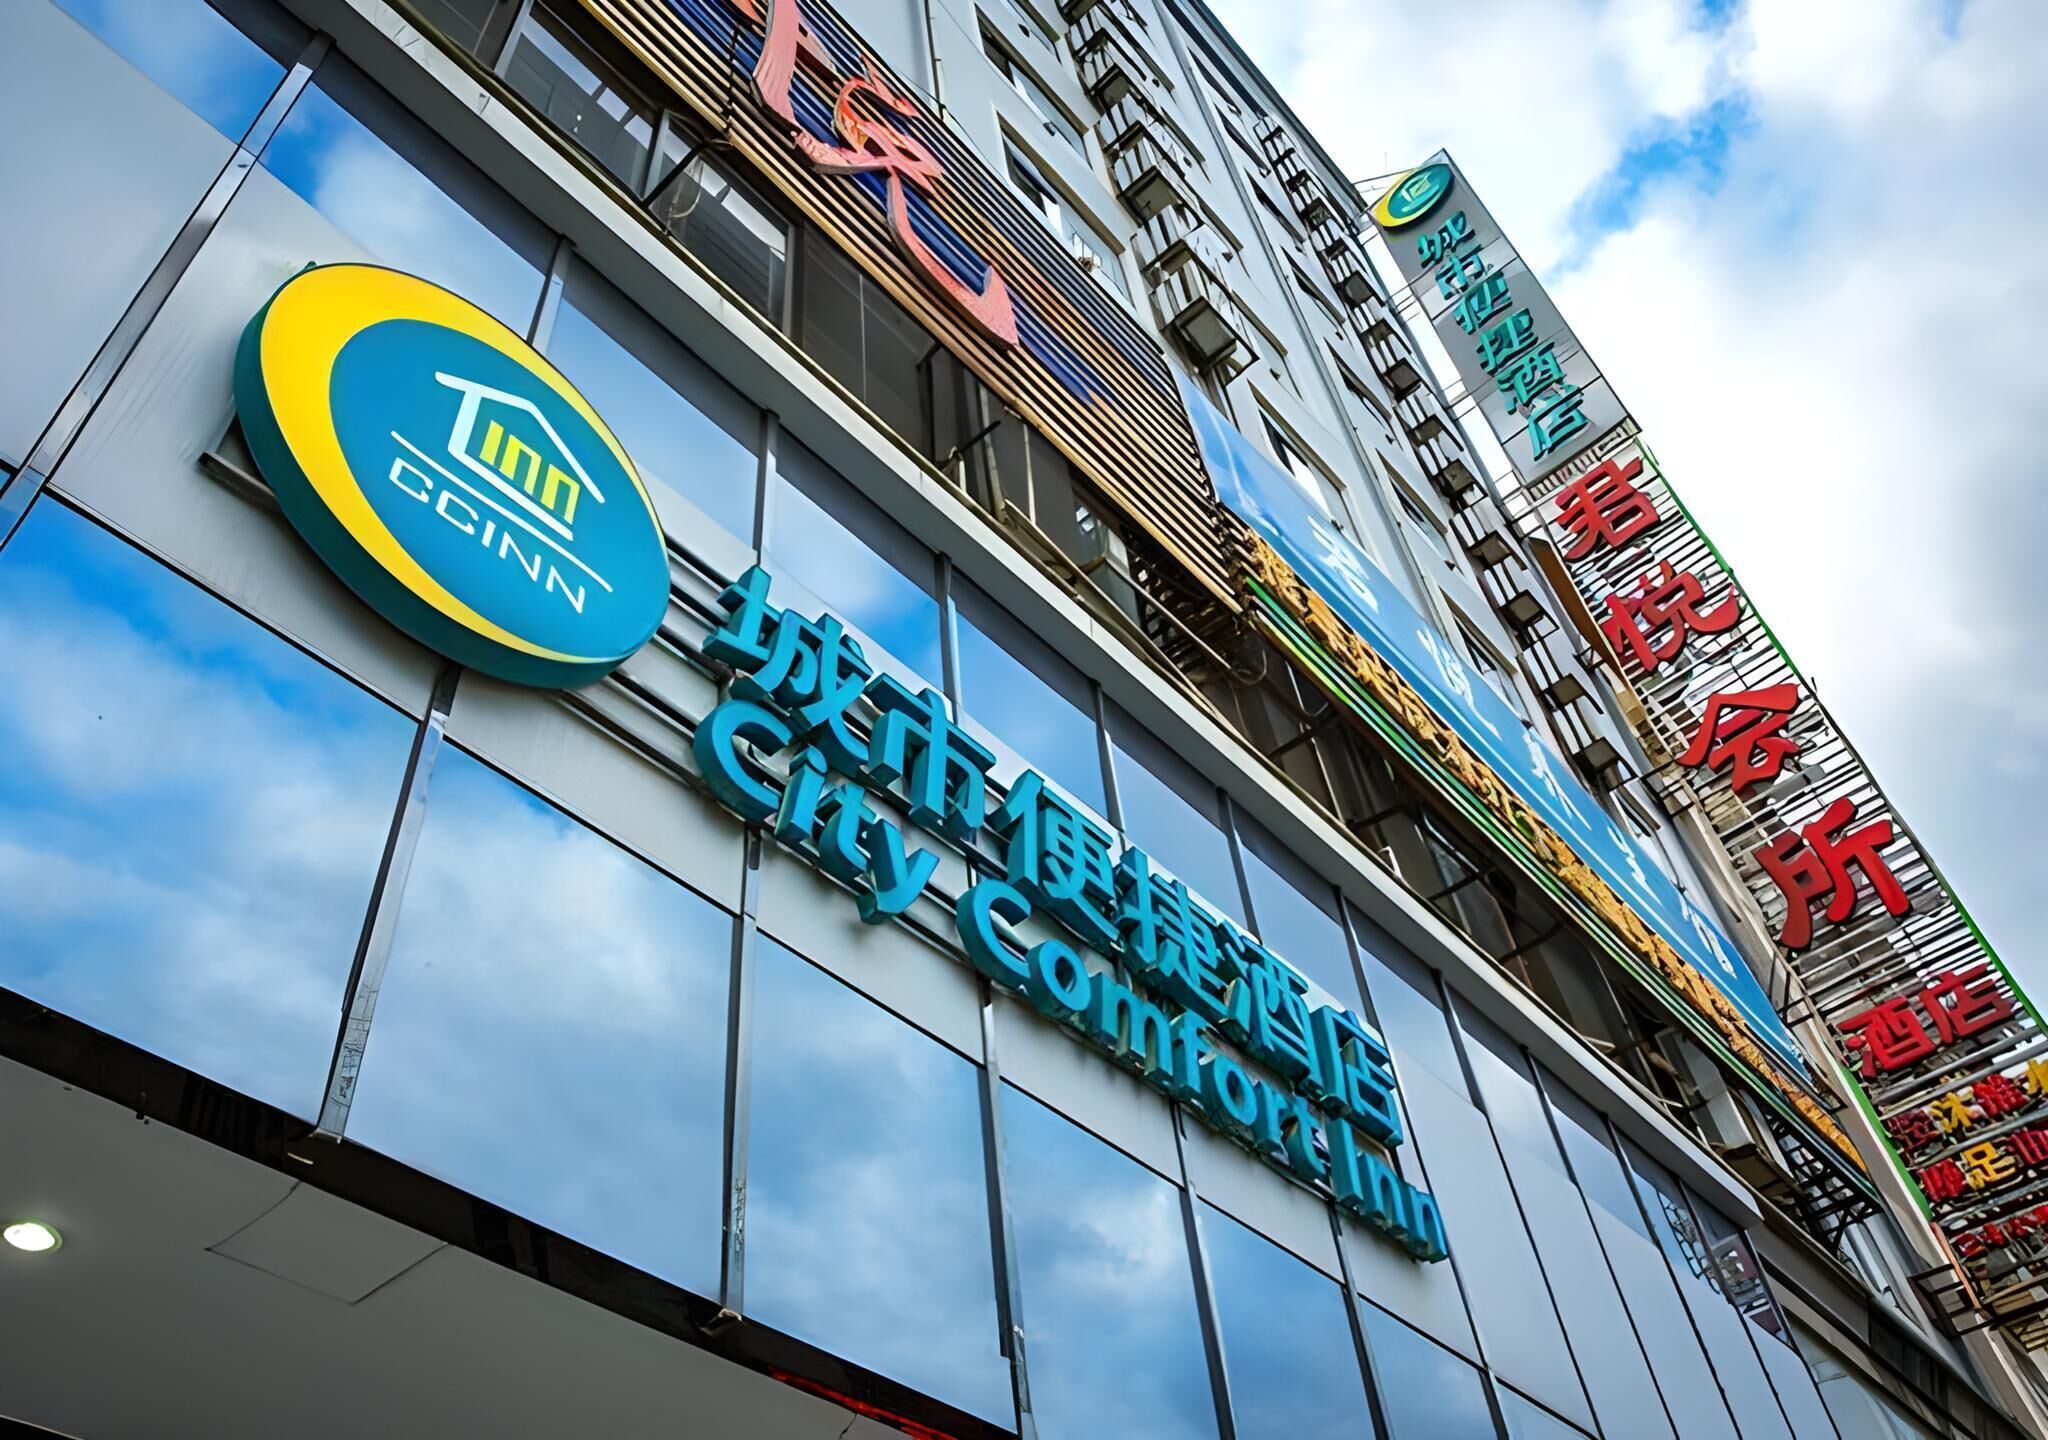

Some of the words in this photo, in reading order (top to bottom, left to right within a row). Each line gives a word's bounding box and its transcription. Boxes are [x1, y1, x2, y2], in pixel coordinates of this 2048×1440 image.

[388, 456, 586, 615] CCINN
[1555, 457, 1911, 950] 君悦会所
[693, 699, 940, 926] City
[956, 879, 1330, 1182] Comfort
[1326, 1115, 1448, 1264] Inn
[702, 564, 1404, 1147] 城市便捷酒店
[1836, 962, 2017, 1080] 酒店
